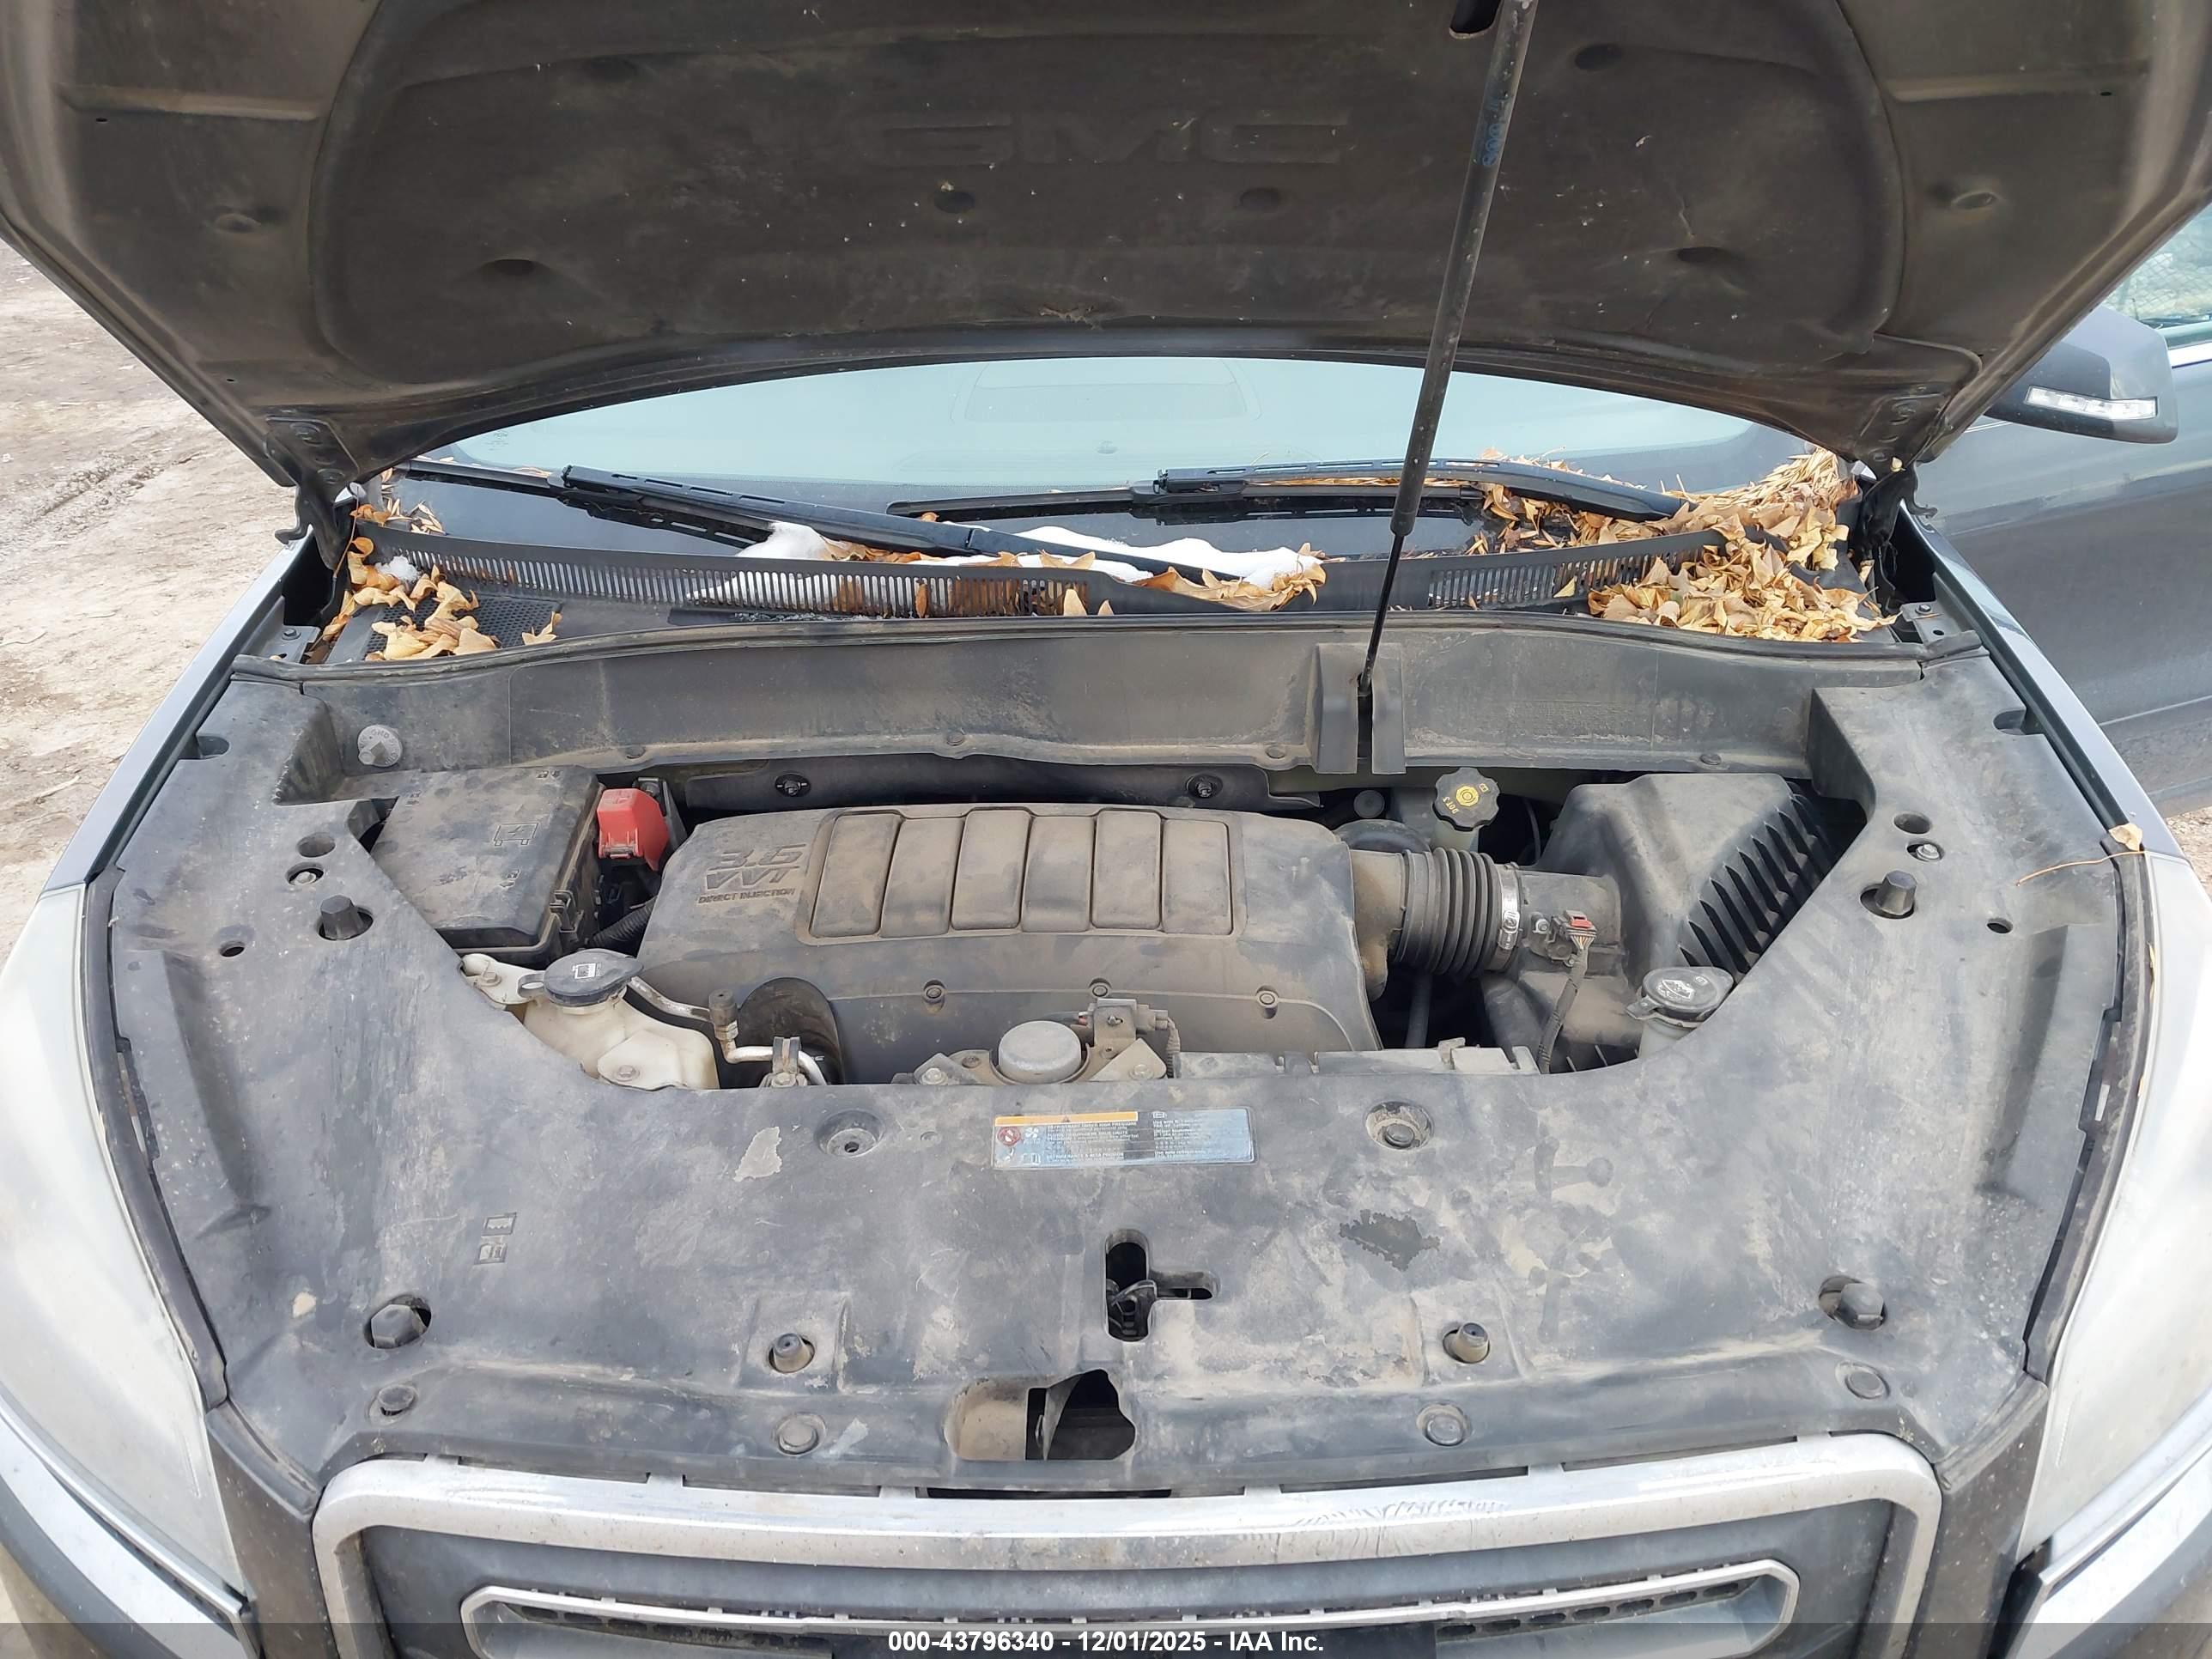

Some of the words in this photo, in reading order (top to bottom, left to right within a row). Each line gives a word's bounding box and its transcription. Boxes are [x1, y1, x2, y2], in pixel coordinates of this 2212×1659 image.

[861, 110, 1349, 167] GMC
[1445, 801, 1460, 815] DOT
[708, 843, 806, 871] 3.6
[706, 866, 800, 890] VVT
[698, 893, 738, 904] DIRECT
[739, 888, 796, 901] INJECTION
